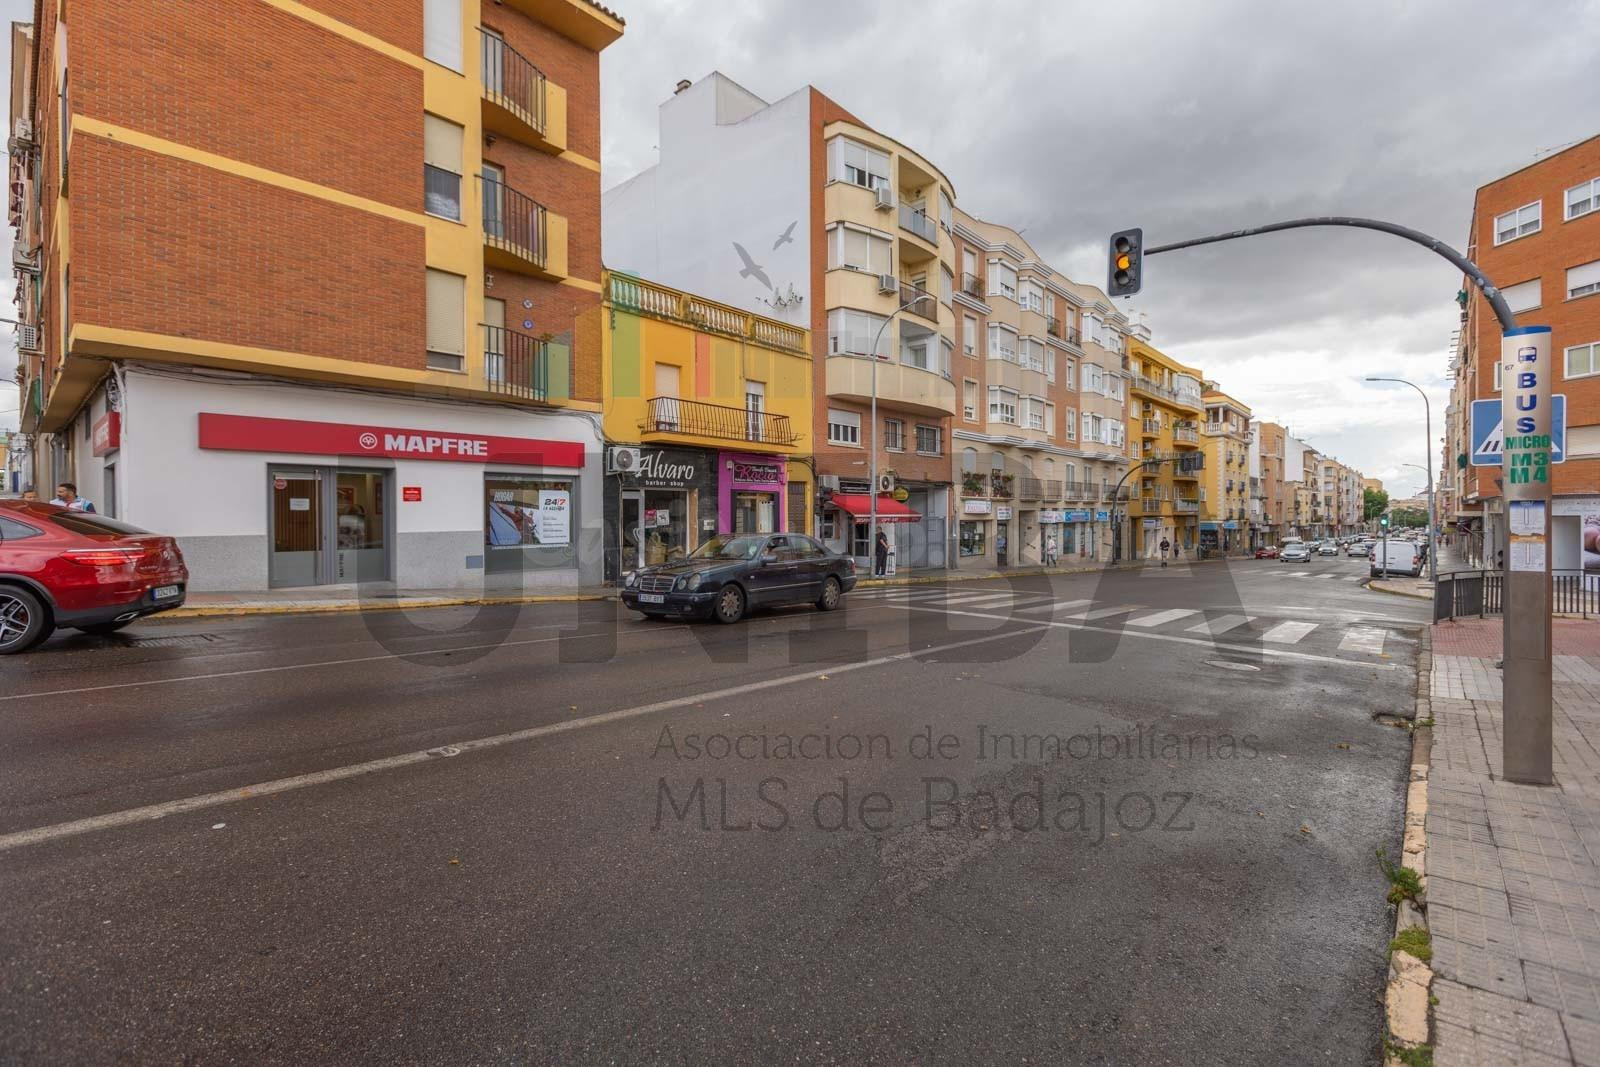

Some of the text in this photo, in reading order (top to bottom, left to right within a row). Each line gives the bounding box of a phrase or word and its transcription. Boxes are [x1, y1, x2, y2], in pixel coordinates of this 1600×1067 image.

[1516, 372, 1537, 434] BUS
[384, 434, 488, 456] MAPFRE
[1505, 435, 1552, 450] MICRO
[634, 450, 694, 480] Alvaro
[1511, 452, 1549, 467] M3
